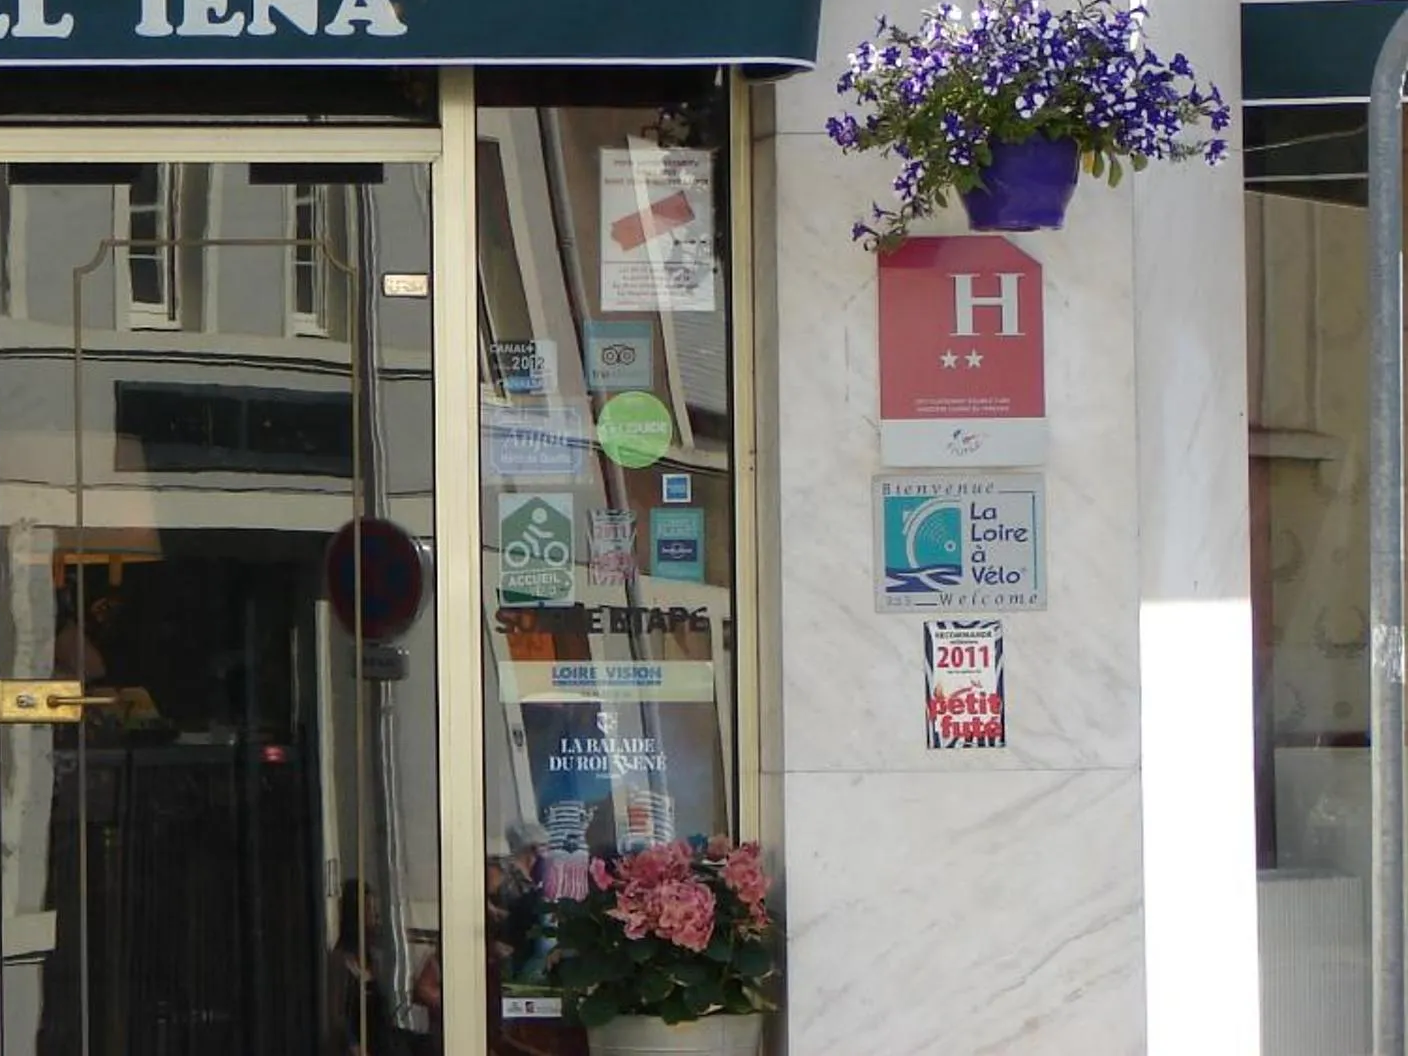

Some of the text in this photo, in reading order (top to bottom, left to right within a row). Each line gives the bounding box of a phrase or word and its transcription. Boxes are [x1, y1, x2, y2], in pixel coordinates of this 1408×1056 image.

[949, 272, 1026, 336] H
[970, 502, 997, 520] La
[970, 523, 1029, 542] Loire
[971, 545, 986, 563] à
[508, 574, 561, 588] ACCUEIL
[972, 565, 1021, 585] Vélo
[939, 593, 1039, 607] Welcome
[937, 646, 990, 668] 2011
[552, 666, 662, 679] LOIRE VISION
[561, 737, 656, 753] LA BALADE
[549, 756, 575, 771] DU
